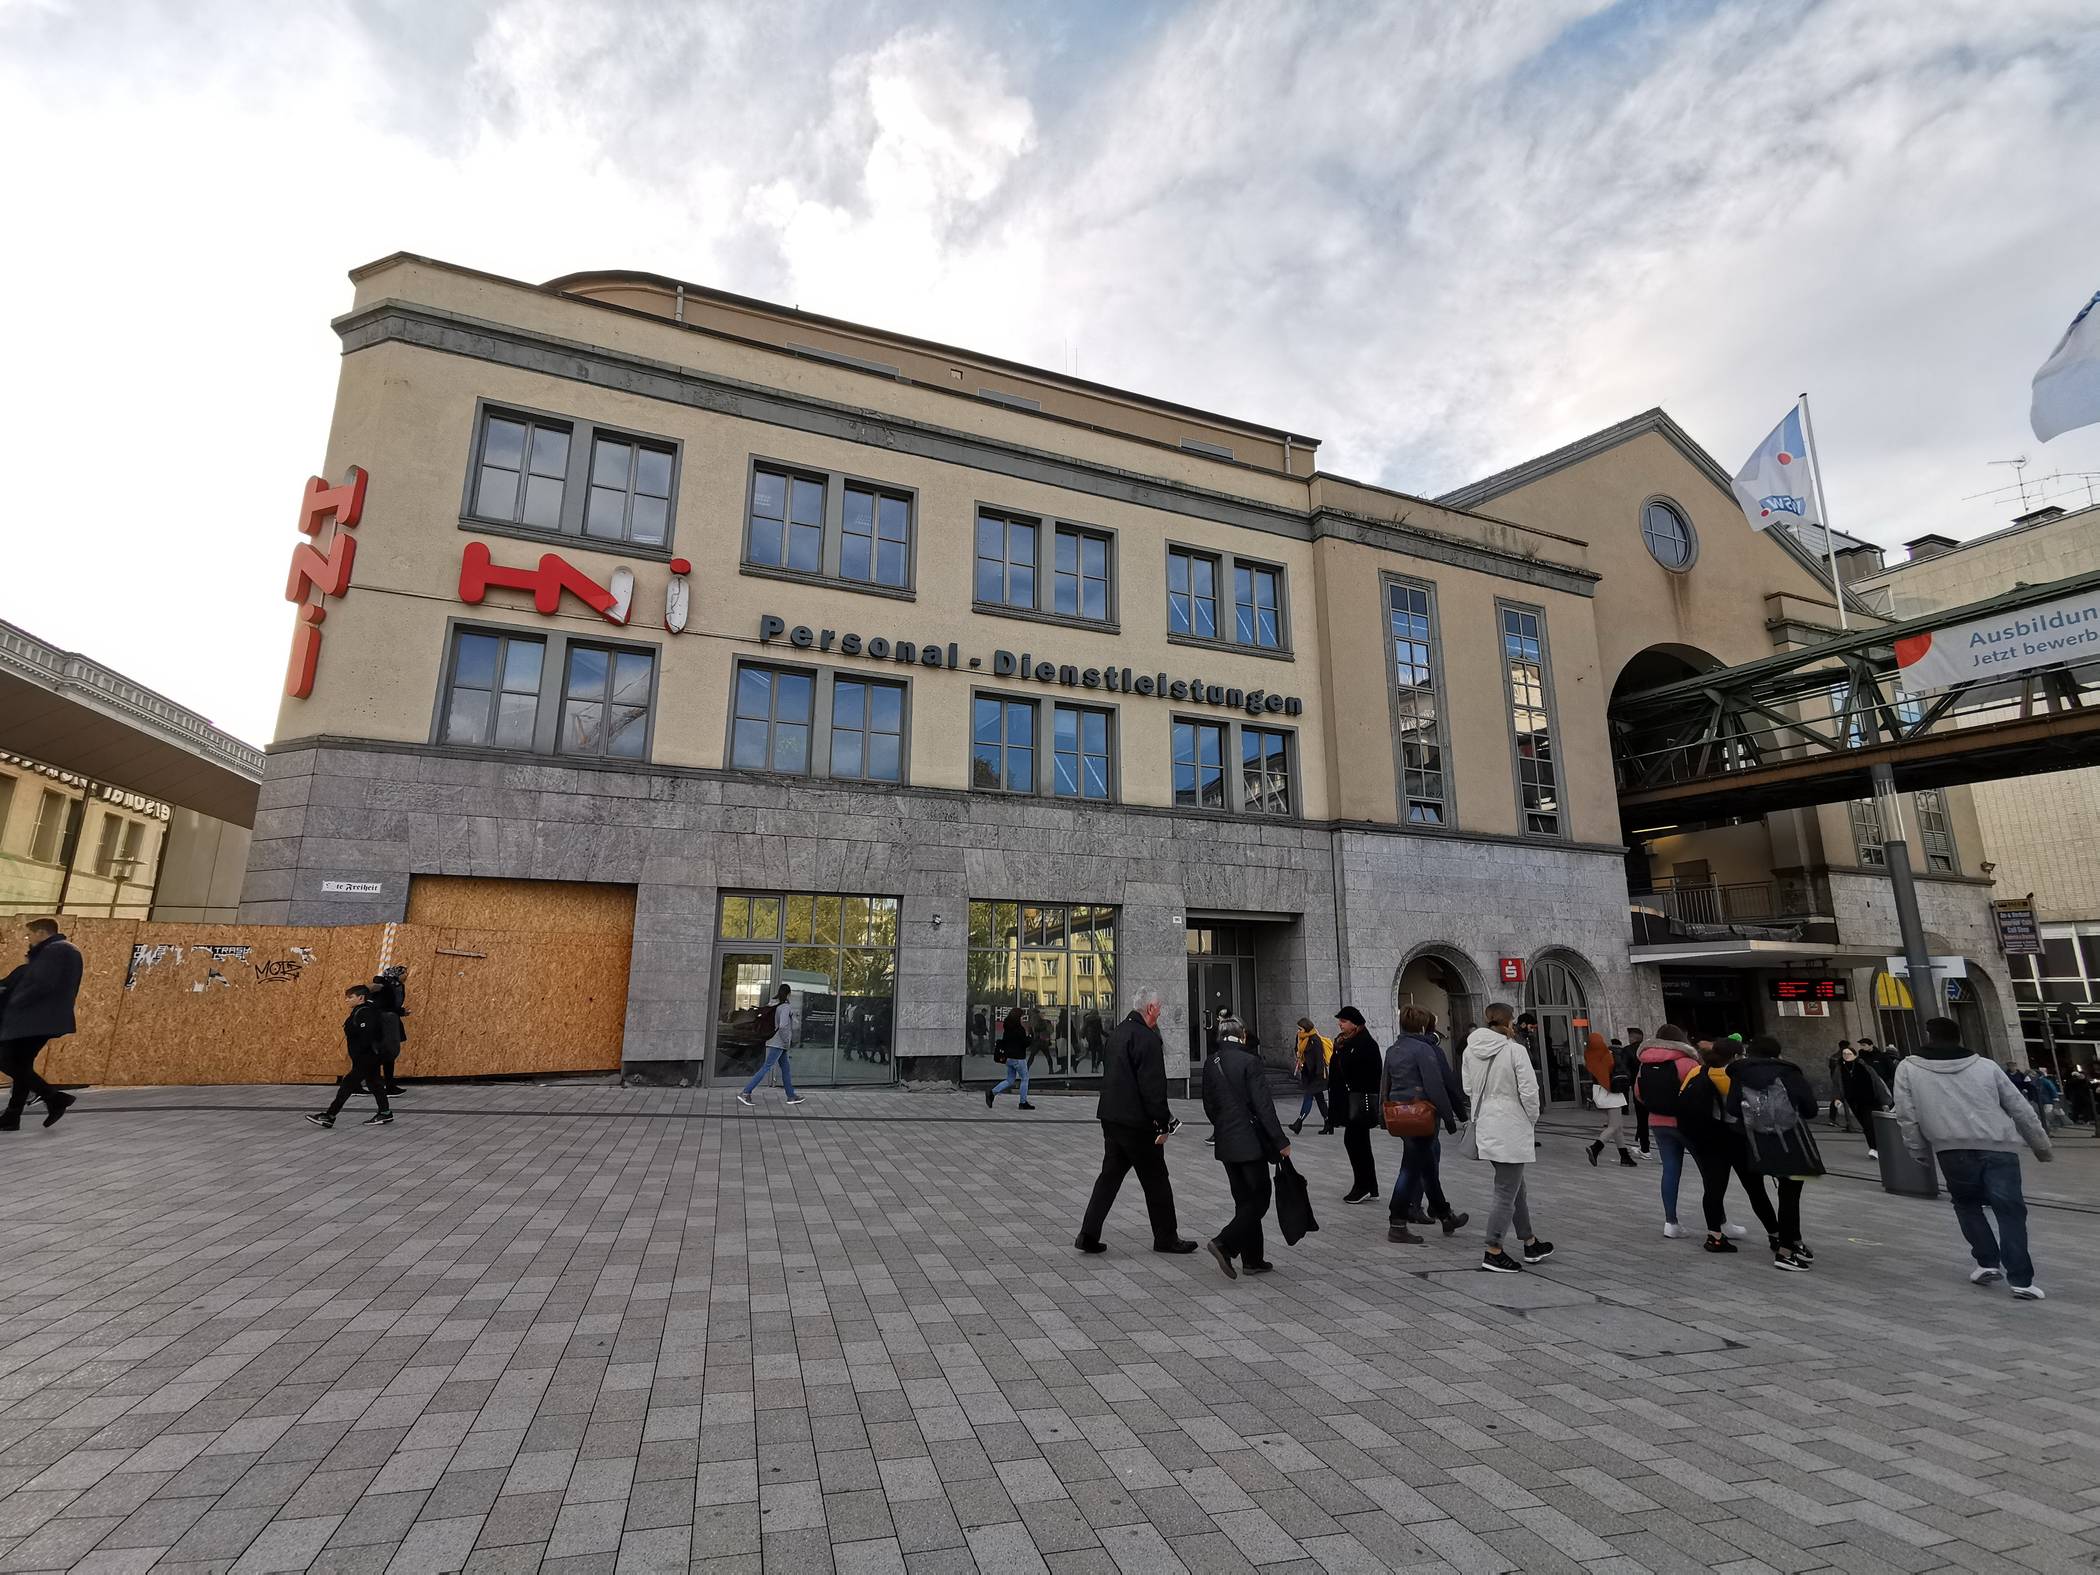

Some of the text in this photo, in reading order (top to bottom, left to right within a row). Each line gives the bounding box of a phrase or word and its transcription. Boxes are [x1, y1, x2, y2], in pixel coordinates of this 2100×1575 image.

[1969, 607, 2098, 648] Ausbildun
[760, 614, 959, 670] Personal
[994, 648, 1304, 716] Dienstleistungen
[1972, 629, 2098, 667] Jetzt bewerb
[345, 884, 378, 892] Freiheit
